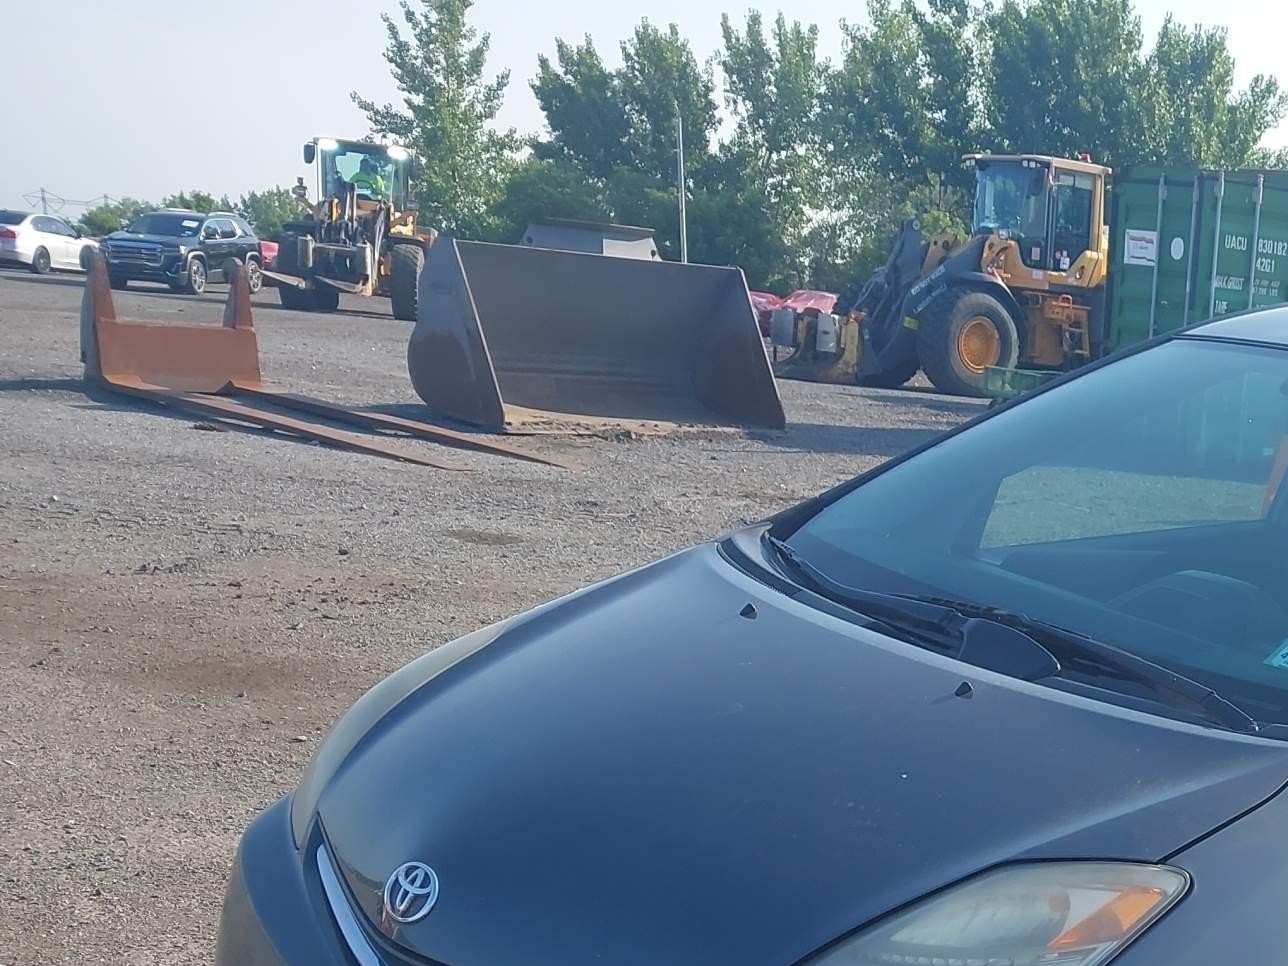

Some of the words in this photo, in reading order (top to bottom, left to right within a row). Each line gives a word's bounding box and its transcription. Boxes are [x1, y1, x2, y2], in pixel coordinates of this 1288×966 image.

[1225, 234, 1248, 251] UACU
[1258, 239, 1288, 256] 830182
[1256, 257, 1275, 273] 42G1
